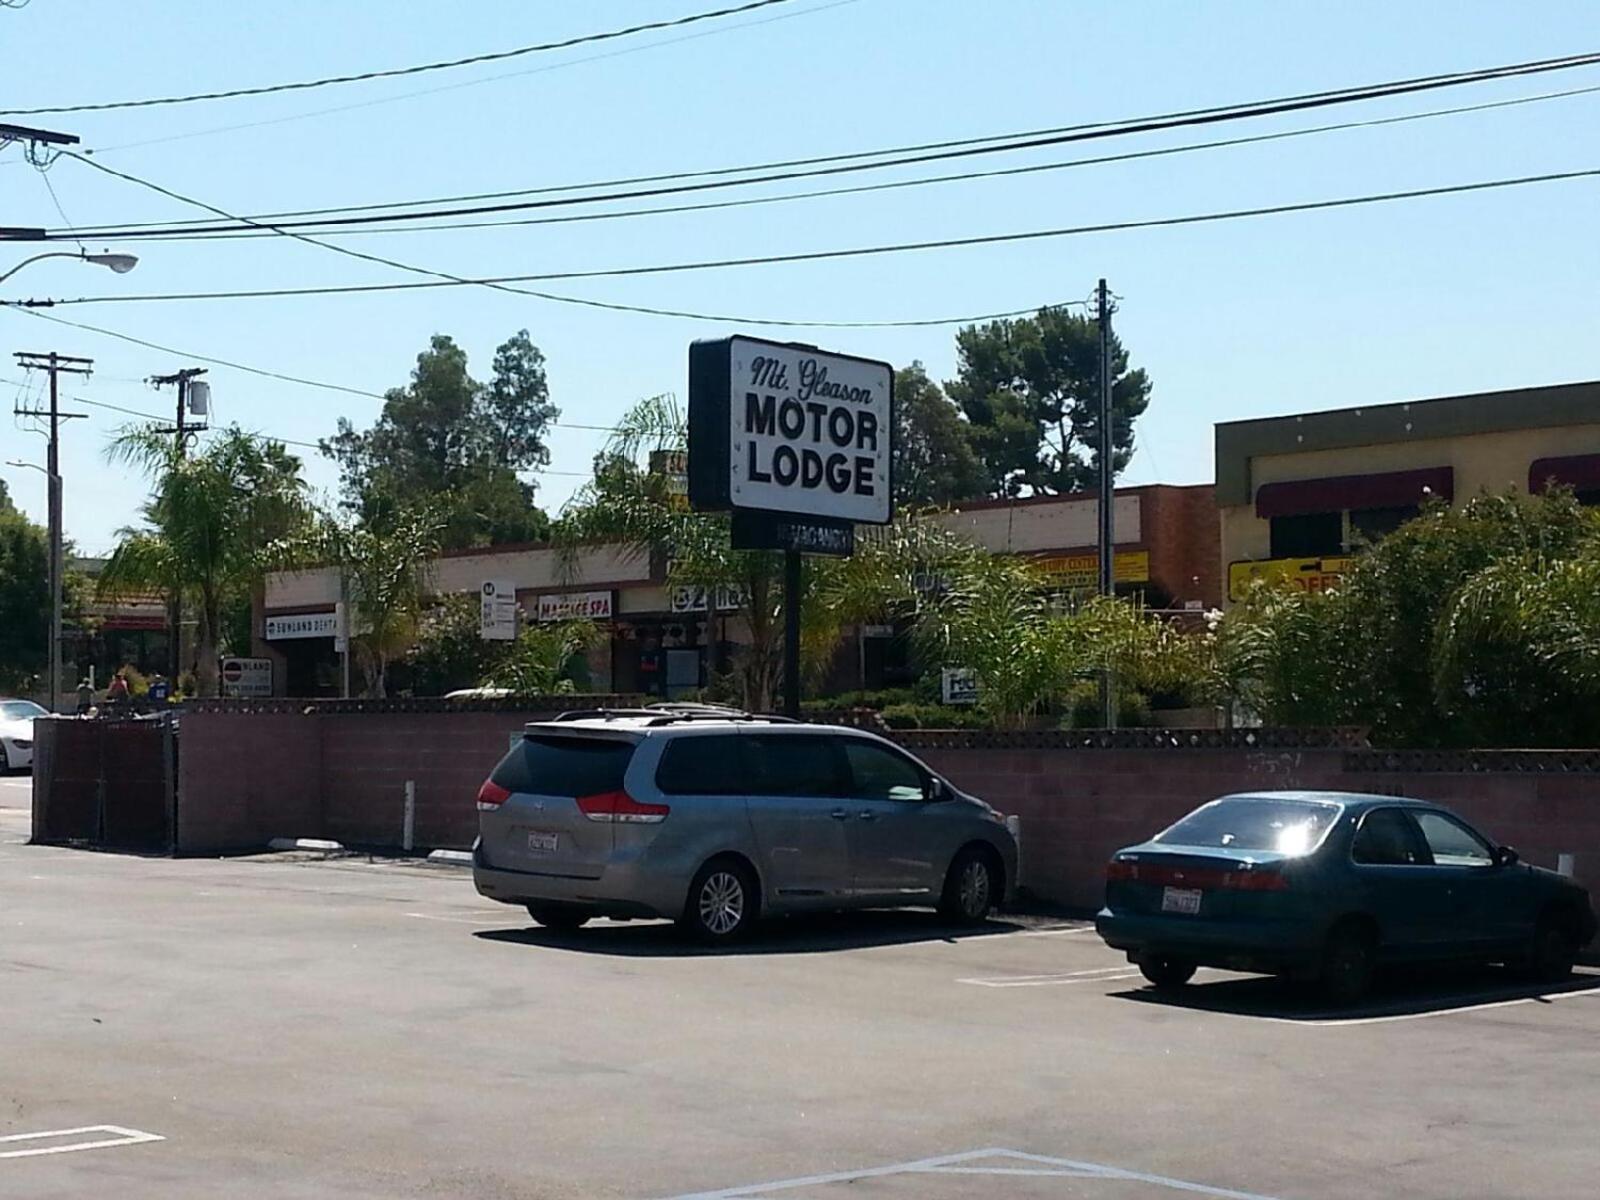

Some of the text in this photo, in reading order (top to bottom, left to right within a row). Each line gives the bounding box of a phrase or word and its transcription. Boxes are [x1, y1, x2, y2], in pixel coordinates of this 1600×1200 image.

[751, 356, 873, 405] Mt. Gleason
[745, 392, 877, 451] MOTOR
[748, 441, 874, 496] LODGE
[590, 599, 610, 615] SPA
